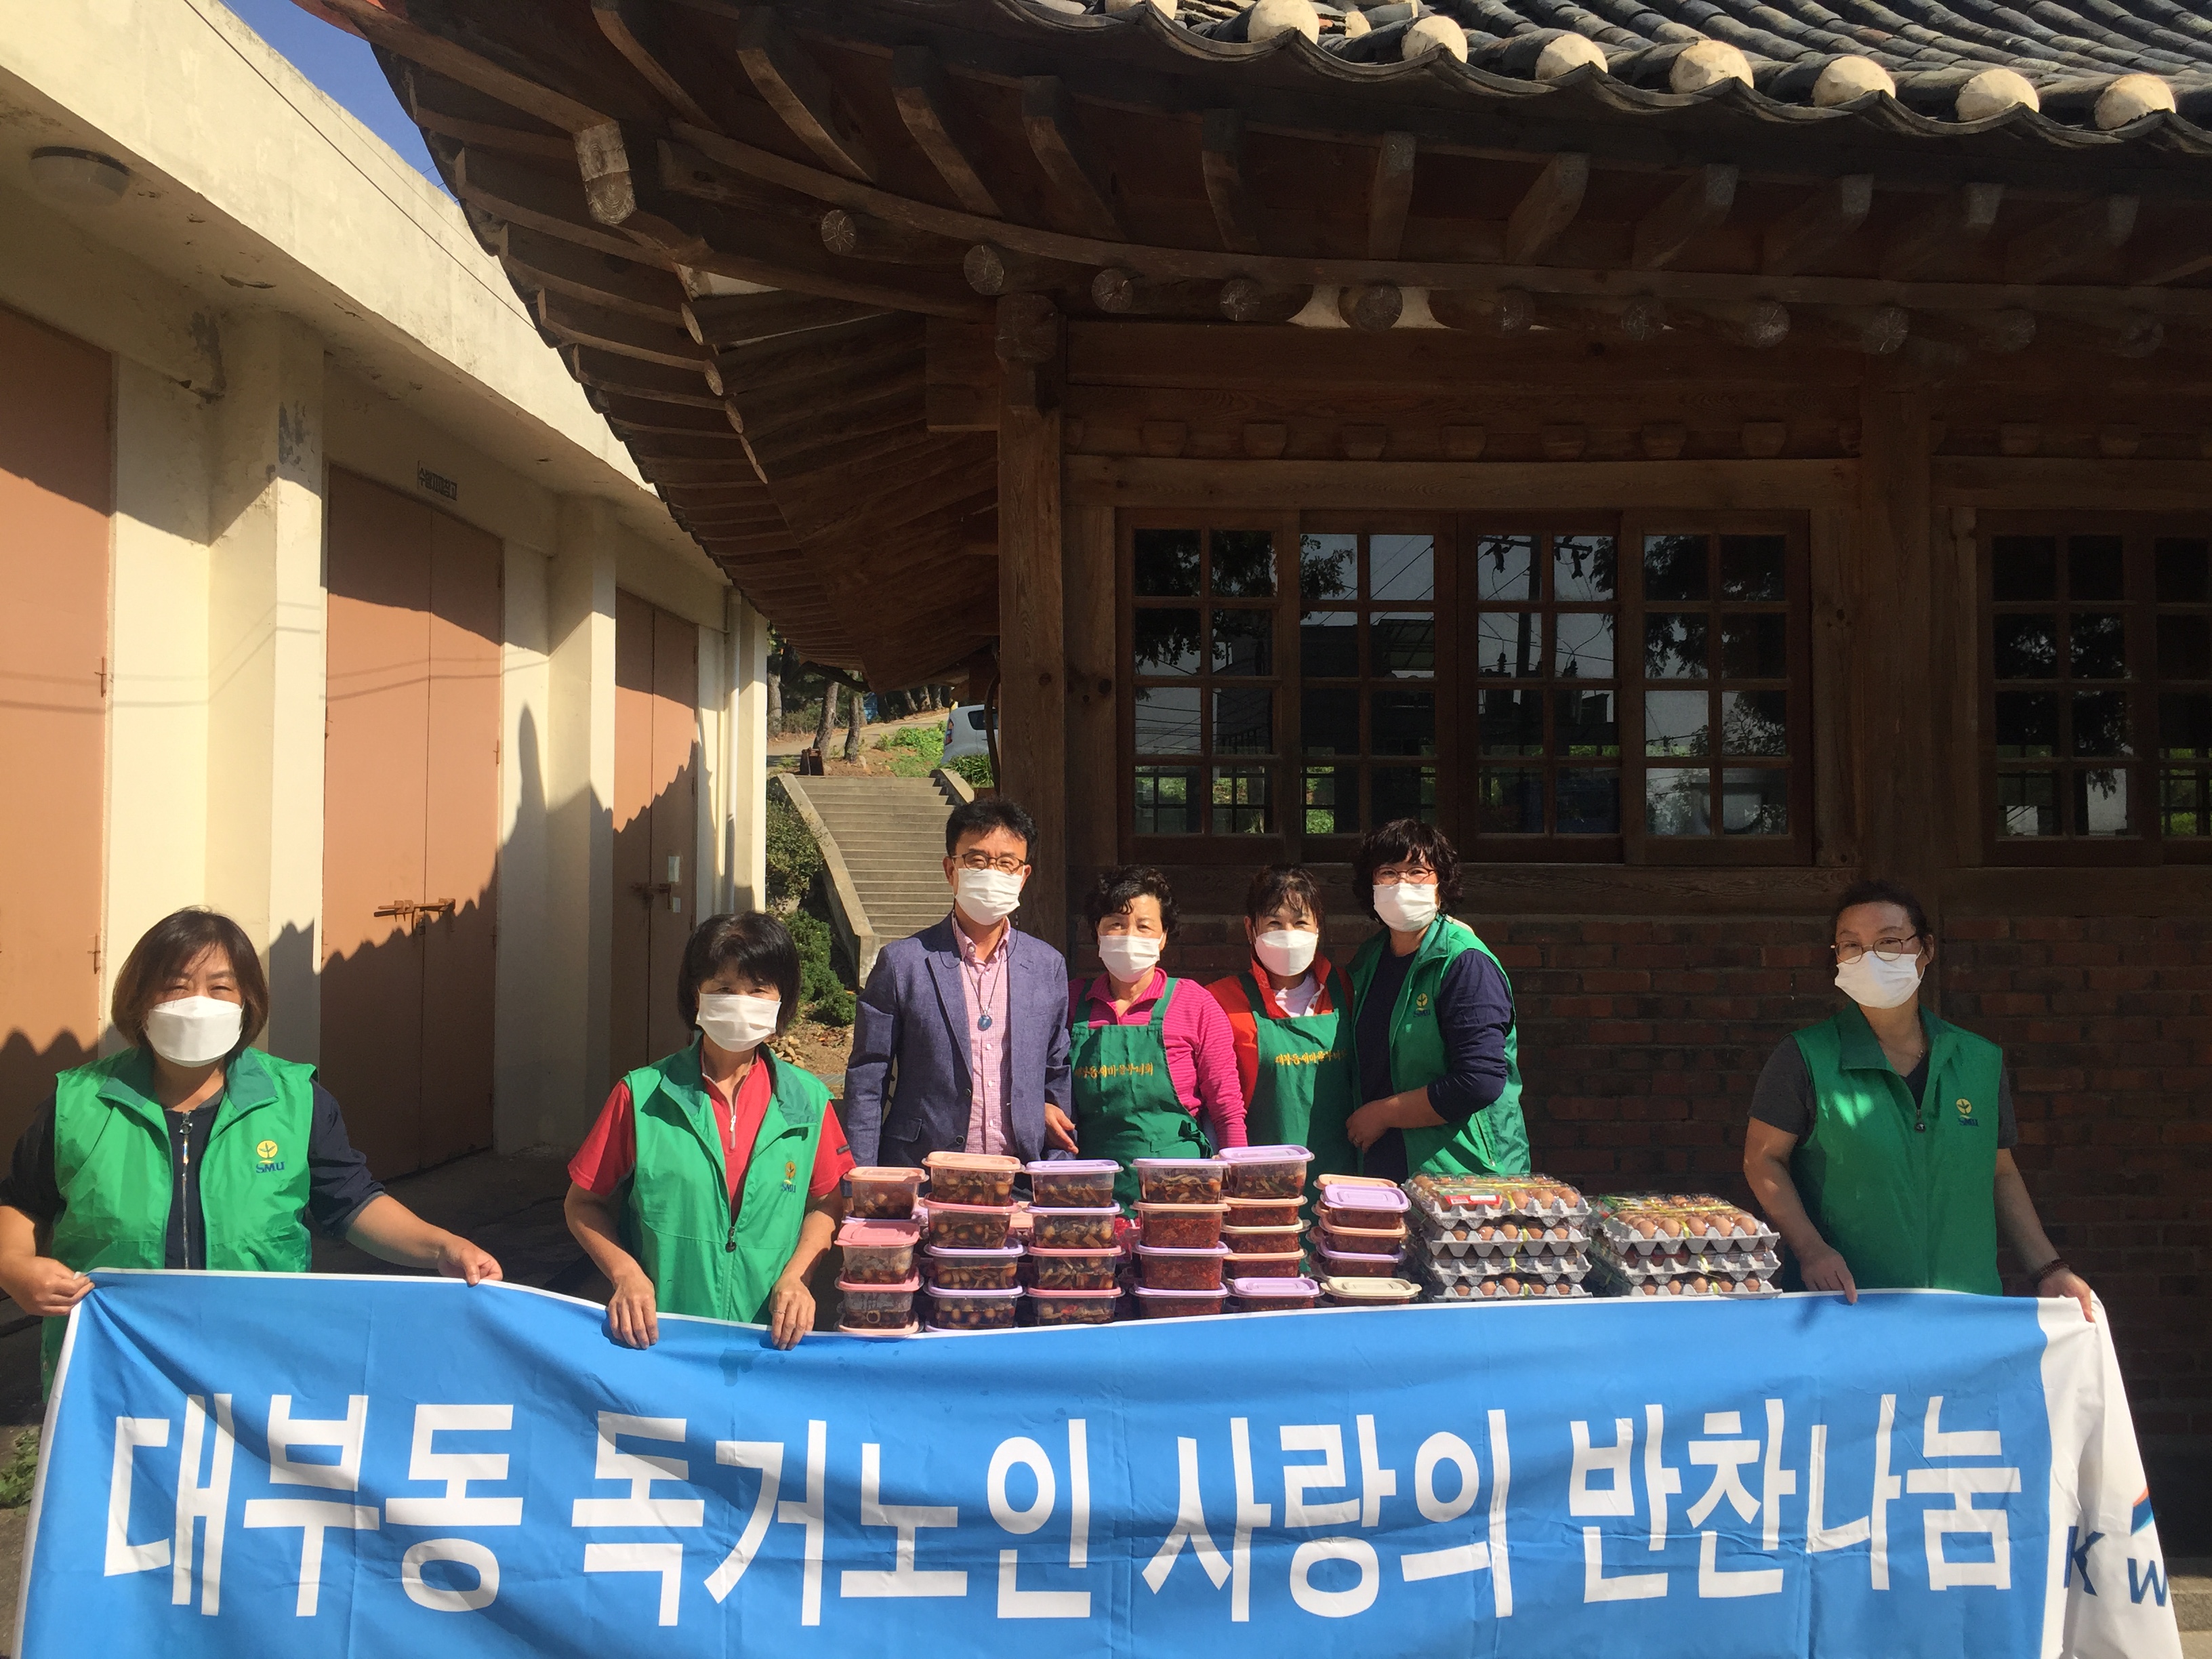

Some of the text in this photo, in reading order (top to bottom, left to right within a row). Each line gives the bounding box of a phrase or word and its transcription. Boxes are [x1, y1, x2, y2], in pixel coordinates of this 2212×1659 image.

[256, 1162, 285, 1173] SMU
[104, 1393, 2022, 1626] 대부동 독거노인 사랑의 반찬나눔
